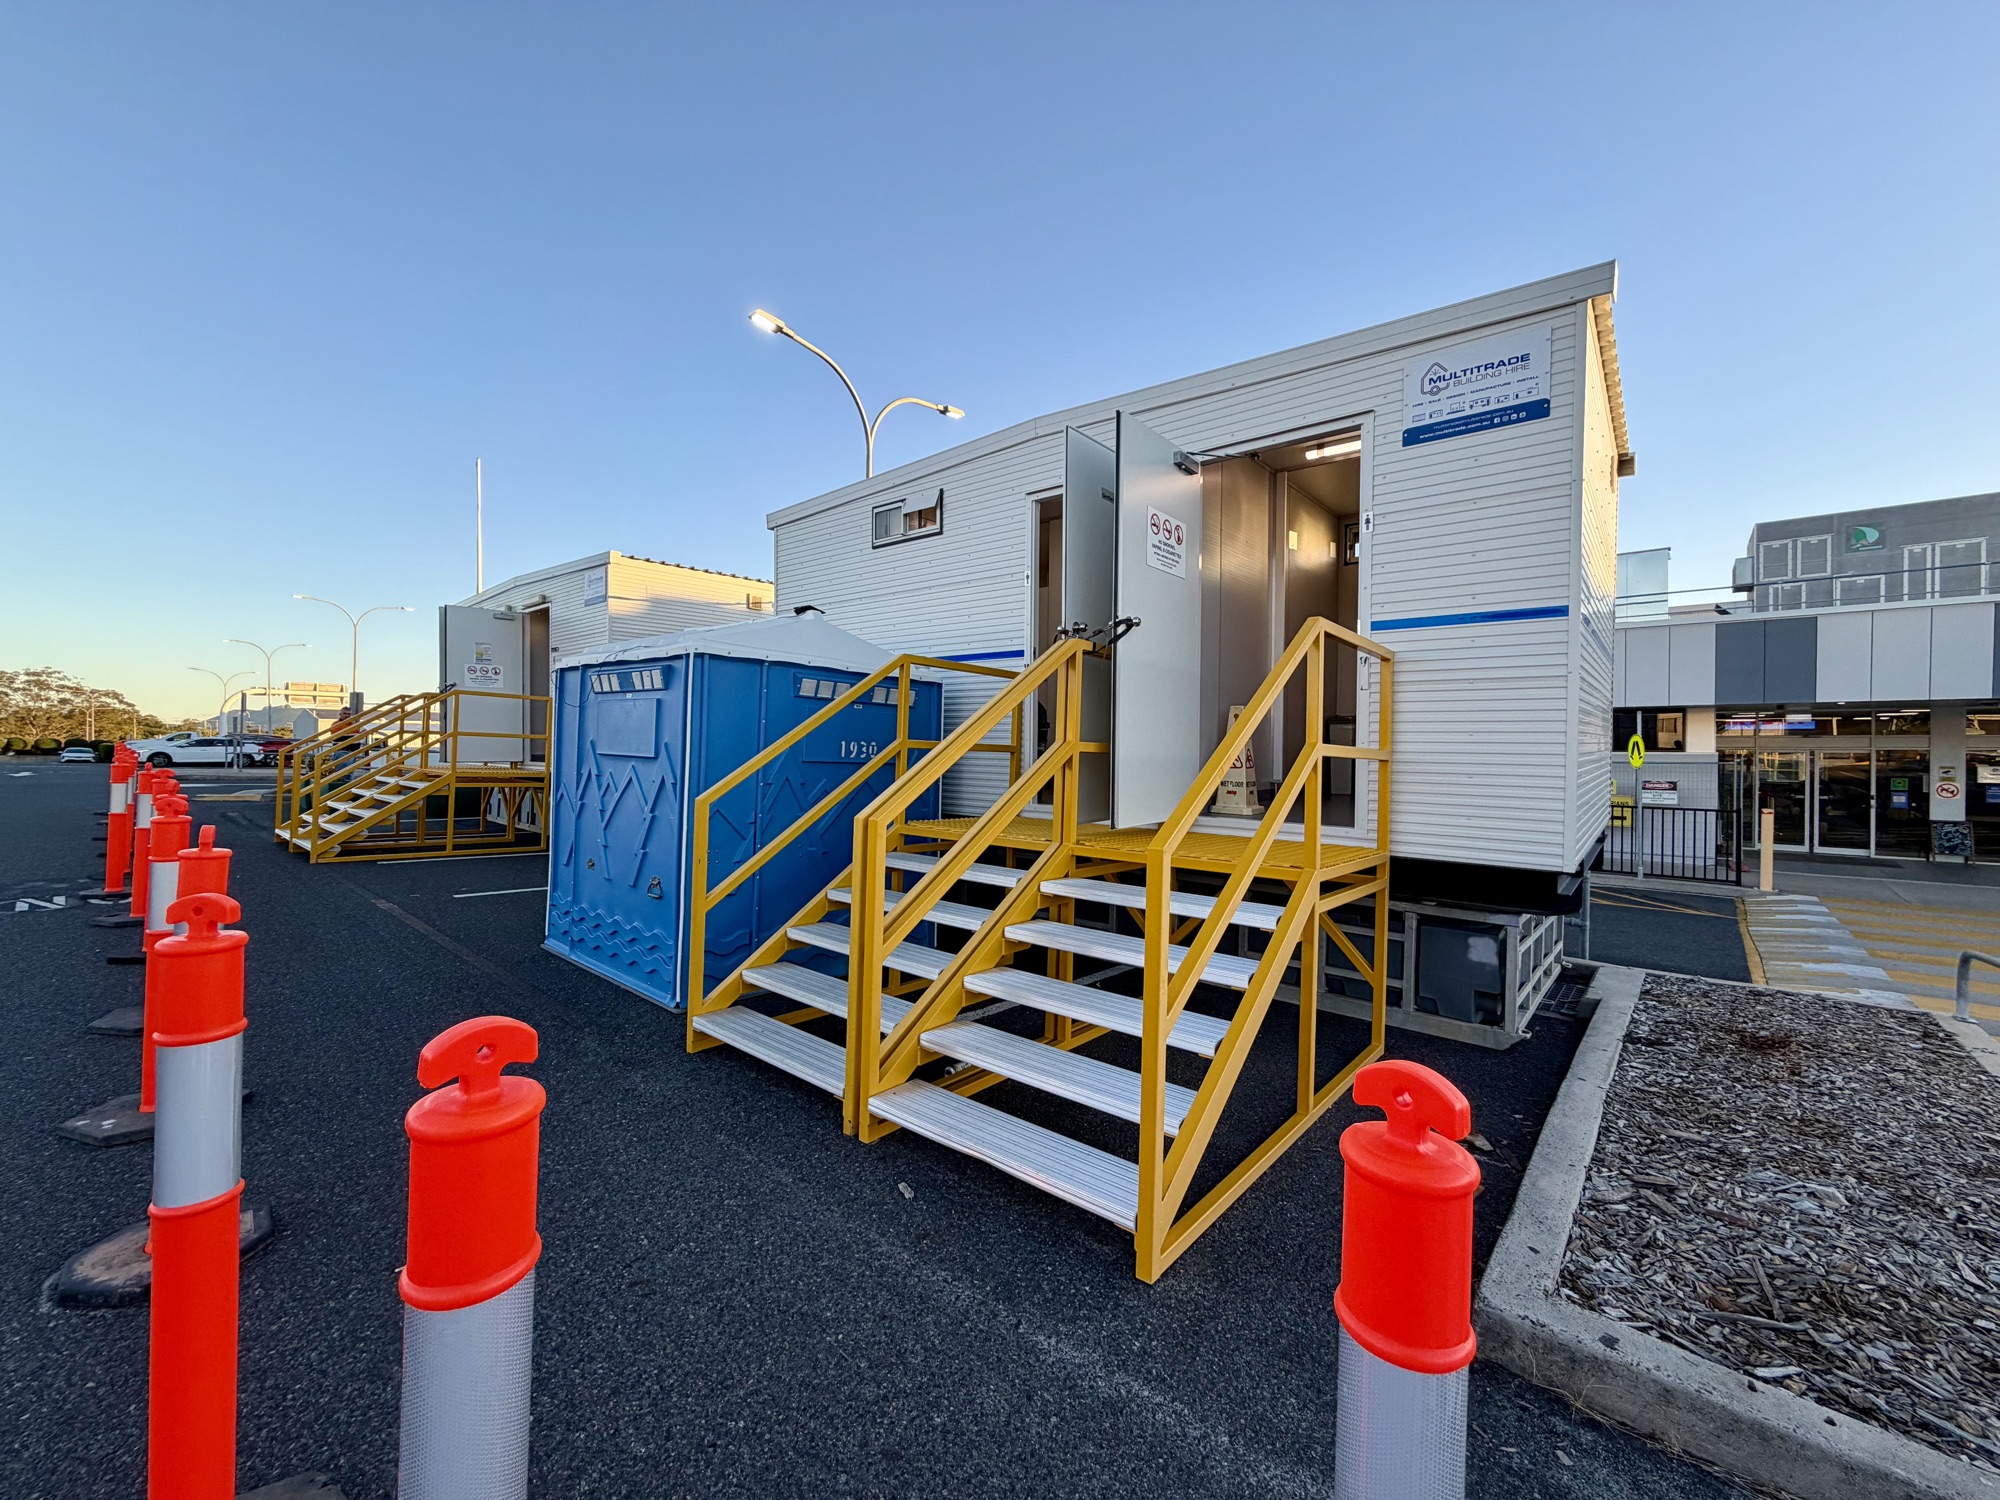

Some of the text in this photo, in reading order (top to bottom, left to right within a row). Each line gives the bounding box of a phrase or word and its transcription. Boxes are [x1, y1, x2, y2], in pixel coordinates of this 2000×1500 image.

[1428, 352, 1531, 386] MULTITRADE
[1453, 362, 1531, 387] BUILDING HIRE
[1470, 381, 1512, 394] MANUFACTURE
[1516, 375, 1540, 383] INSTALL
[1419, 420, 1491, 439] www.multitrade.com.au
[840, 740, 878, 758] 1930
